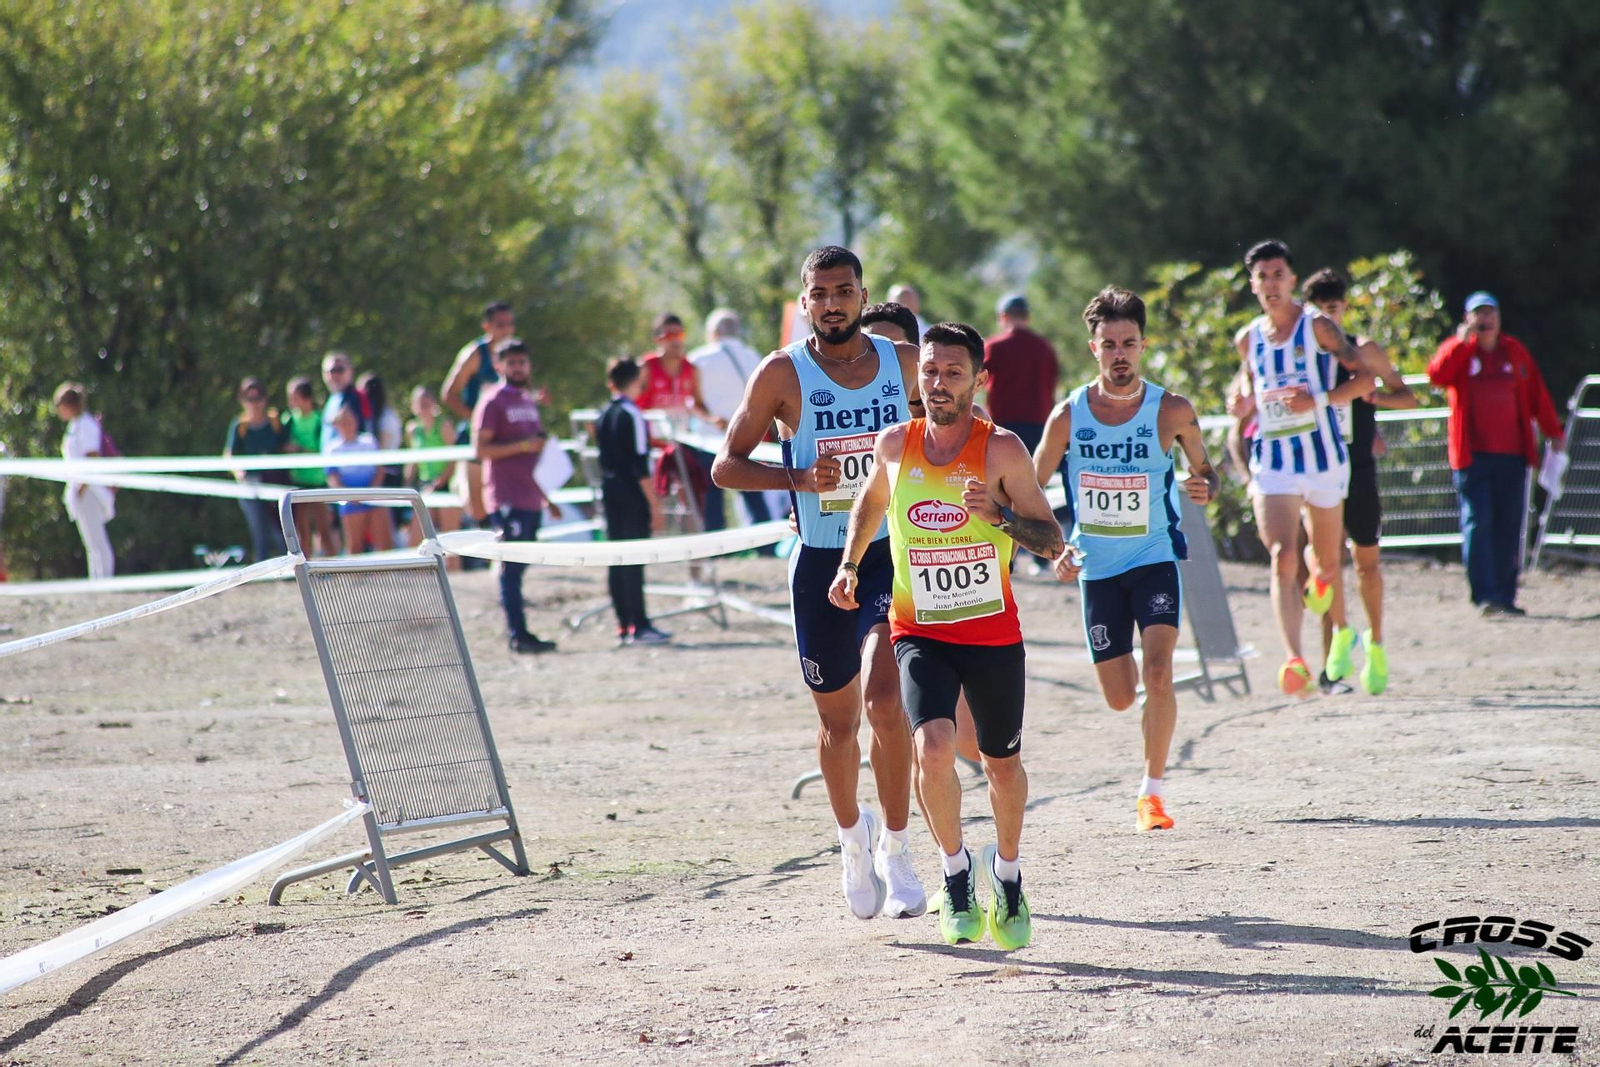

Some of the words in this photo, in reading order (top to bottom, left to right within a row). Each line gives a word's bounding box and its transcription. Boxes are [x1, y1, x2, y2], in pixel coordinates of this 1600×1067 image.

[811, 392, 834, 404] TROPS
[814, 399, 900, 432] nerja
[841, 436, 874, 452] INTERNACIONAL
[1078, 437, 1150, 463] nerja
[840, 453, 874, 480] 00
[1090, 465, 1140, 473] ATLETISMO
[1085, 489, 1140, 511] 1013
[913, 508, 964, 522] Serrano
[927, 536, 943, 544] BIEN
[951, 536, 973, 544] CORRE
[917, 551, 932, 564] CROSS
[931, 549, 967, 564] INTERNACIONAL
[967, 548, 977, 560] DEL
[977, 545, 994, 559] ACEITE
[918, 562, 990, 592] 1003
[952, 589, 977, 598] Moreno
[934, 602, 952, 610] Juan
[953, 597, 984, 607] Antonio
